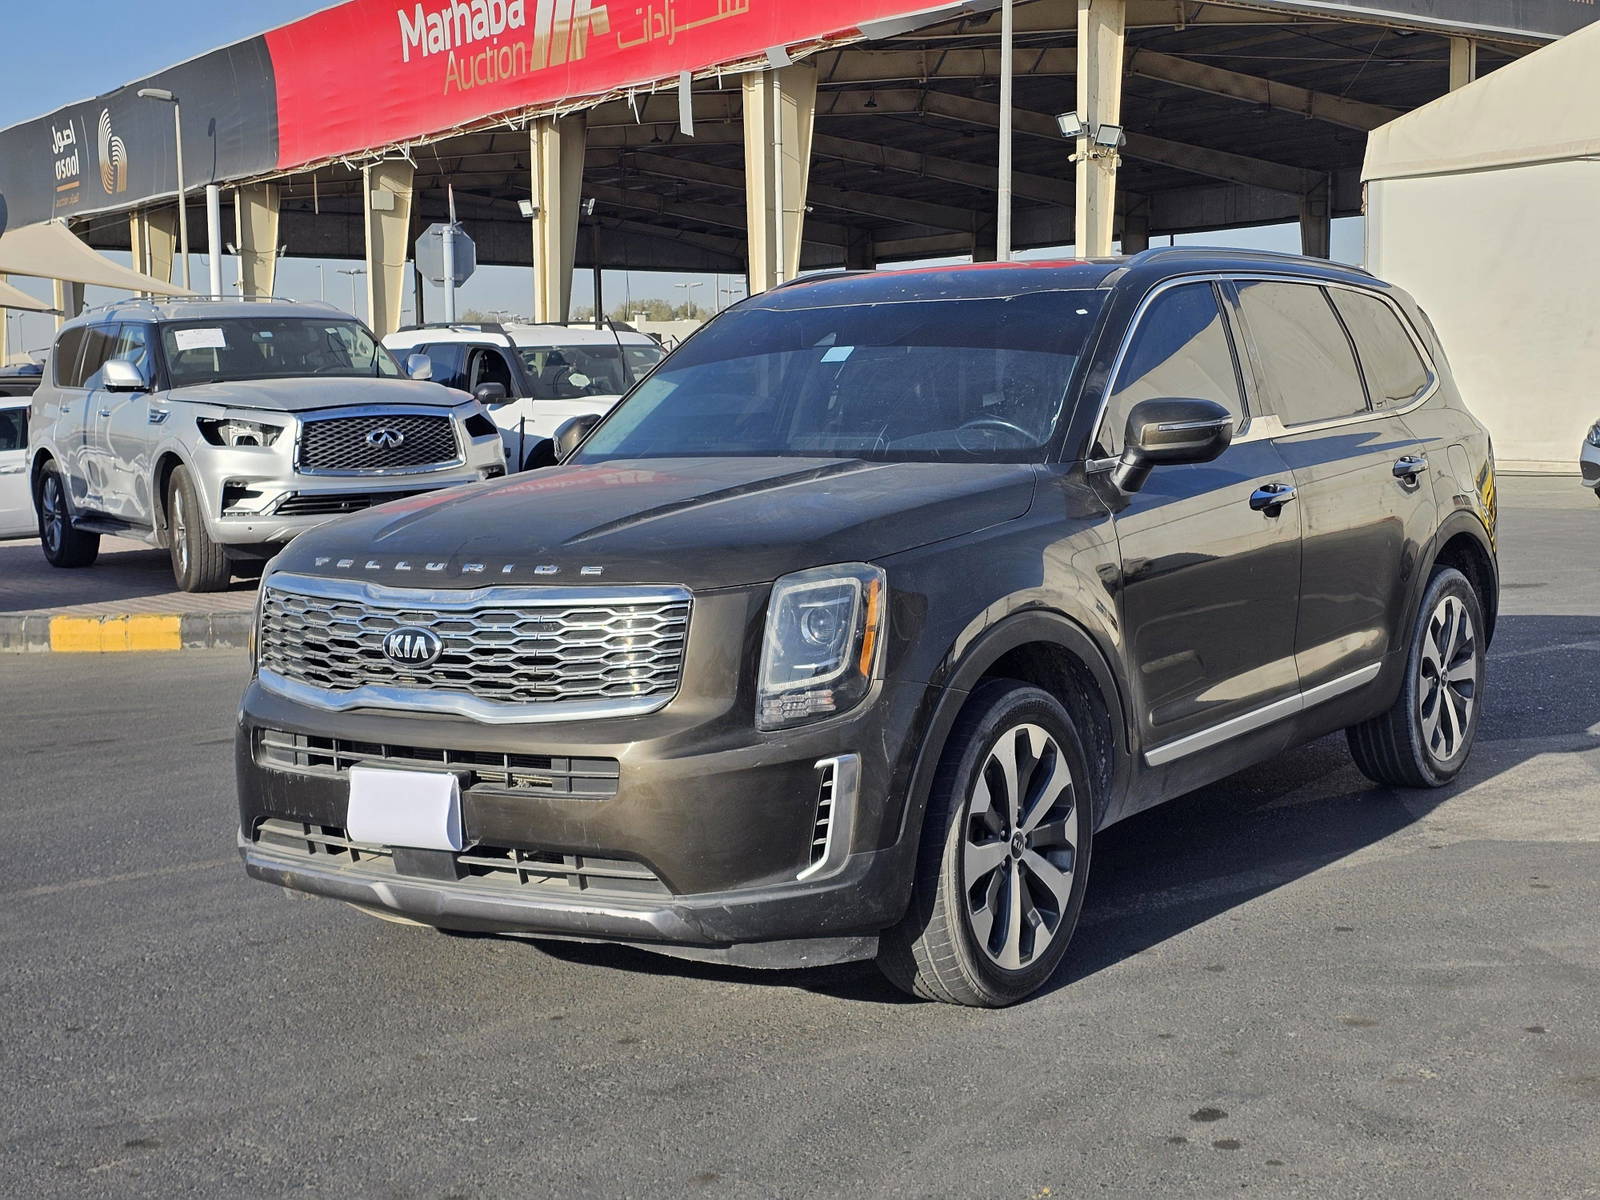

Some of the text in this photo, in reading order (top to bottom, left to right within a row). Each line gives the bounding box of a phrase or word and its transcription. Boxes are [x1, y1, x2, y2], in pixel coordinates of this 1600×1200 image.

[397, 0, 526, 63] Marhaba
[443, 37, 526, 96] Auction
[314, 555, 604, 576] TELLURIDE
[388, 633, 429, 659] KIA
